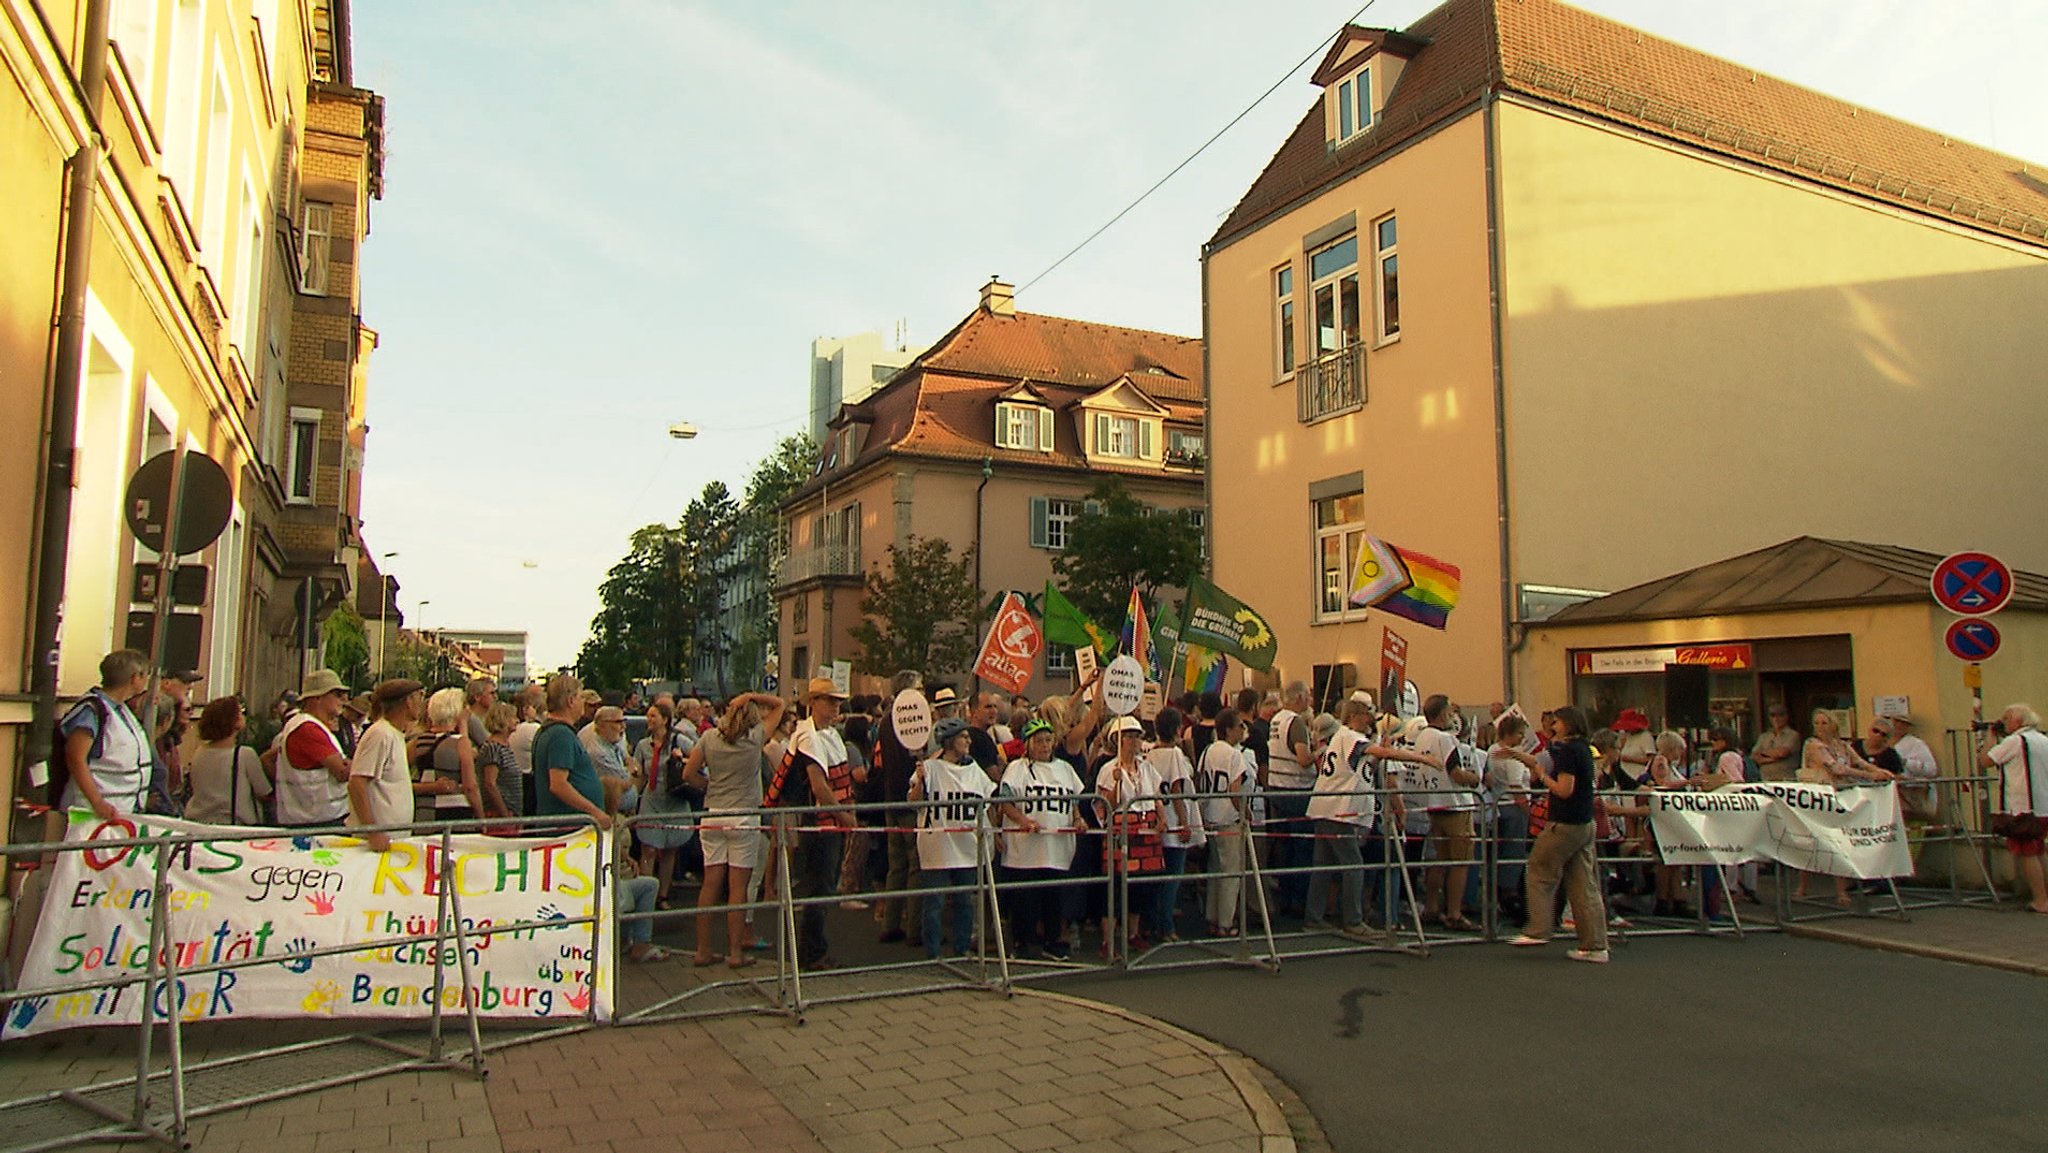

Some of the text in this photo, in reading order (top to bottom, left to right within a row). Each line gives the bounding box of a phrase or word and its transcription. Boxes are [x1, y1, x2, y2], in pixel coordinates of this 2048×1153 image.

[1190, 616, 1241, 642] DIE GRÜNEN
[984, 652, 1028, 683] attac
[1111, 668, 1134, 677] OMAS
[1109, 680, 1136, 689] GEGEN
[1108, 691, 1139, 701] RECHTS
[896, 704, 918, 713] OMAS
[898, 715, 923, 724] GEGEN
[900, 726, 929, 735] RECHTS
[1660, 794, 1760, 812] FORCHHEIM
[83, 818, 243, 874] OMAS
[246, 866, 343, 902] gegen
[372, 842, 594, 897] RECHTS
[71, 877, 210, 914] Erlanen
[353, 938, 479, 967] Sachsen
[352, 970, 553, 1016] Brandenburg
